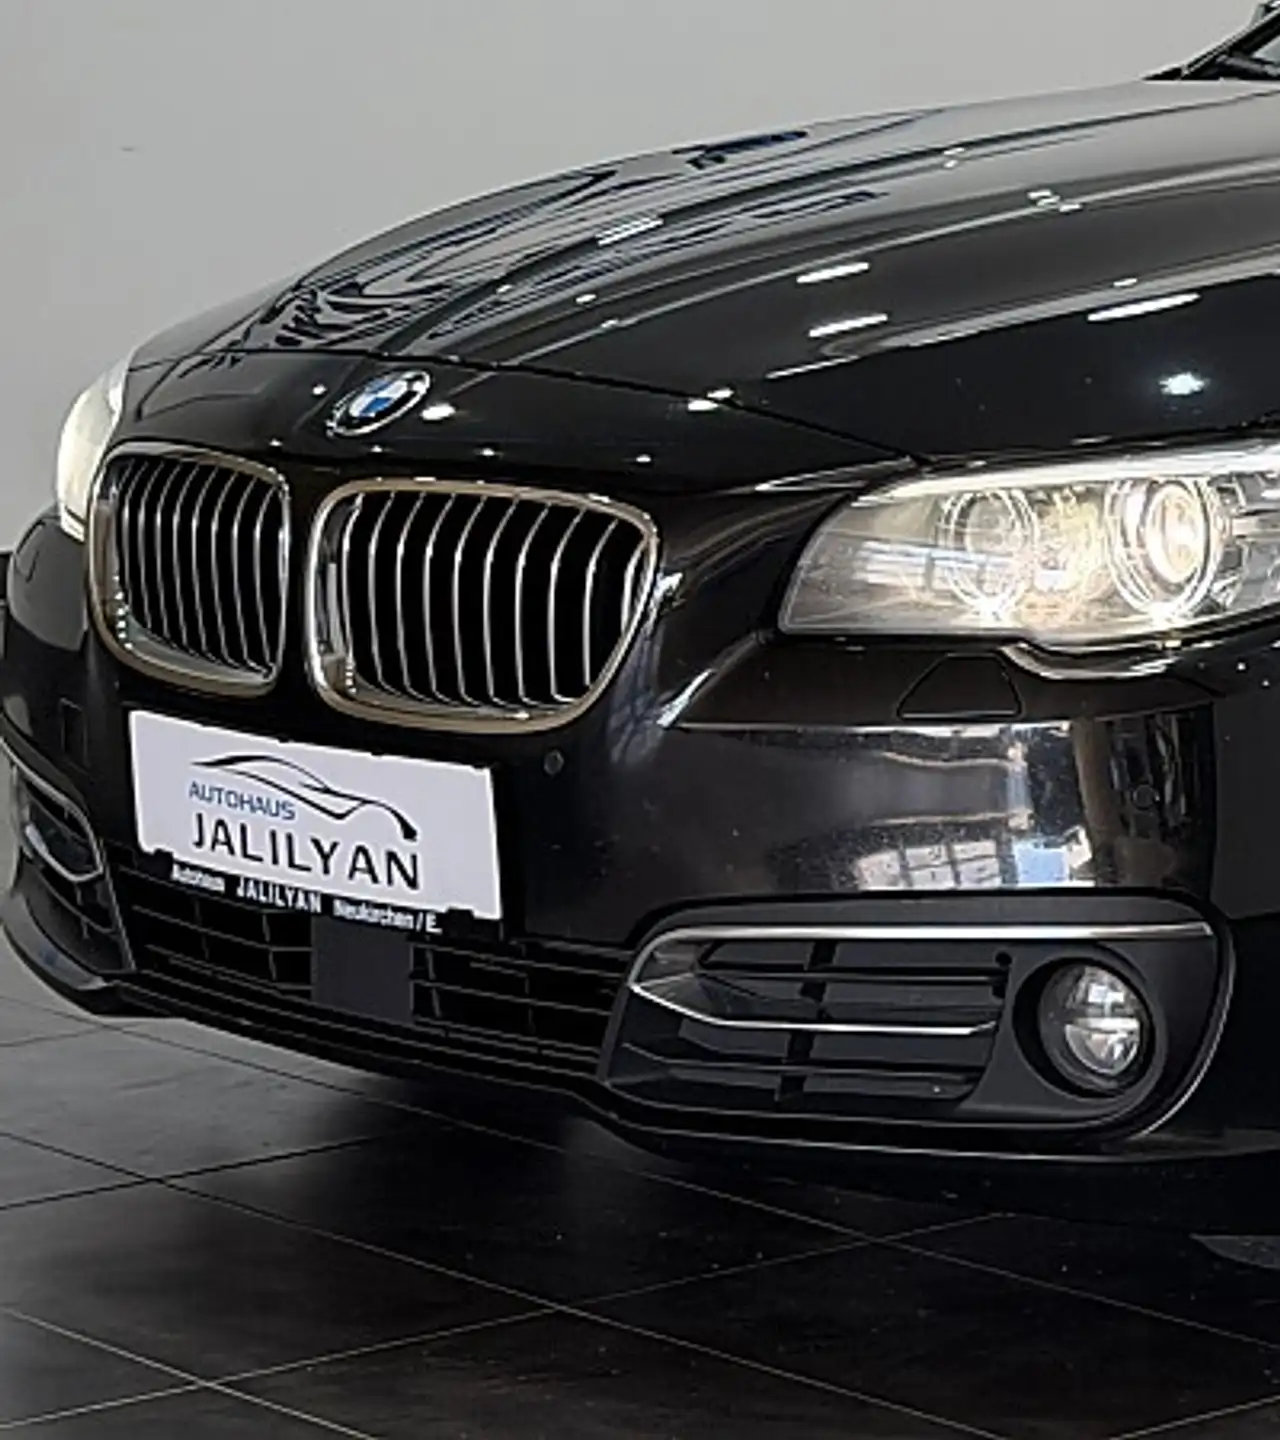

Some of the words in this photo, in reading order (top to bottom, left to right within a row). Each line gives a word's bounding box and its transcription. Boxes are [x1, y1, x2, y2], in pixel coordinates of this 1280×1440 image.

[188, 781, 297, 821] AUTOHAUS
[192, 812, 420, 890] JALILYAN
[236, 876, 322, 913] JALILYAN
